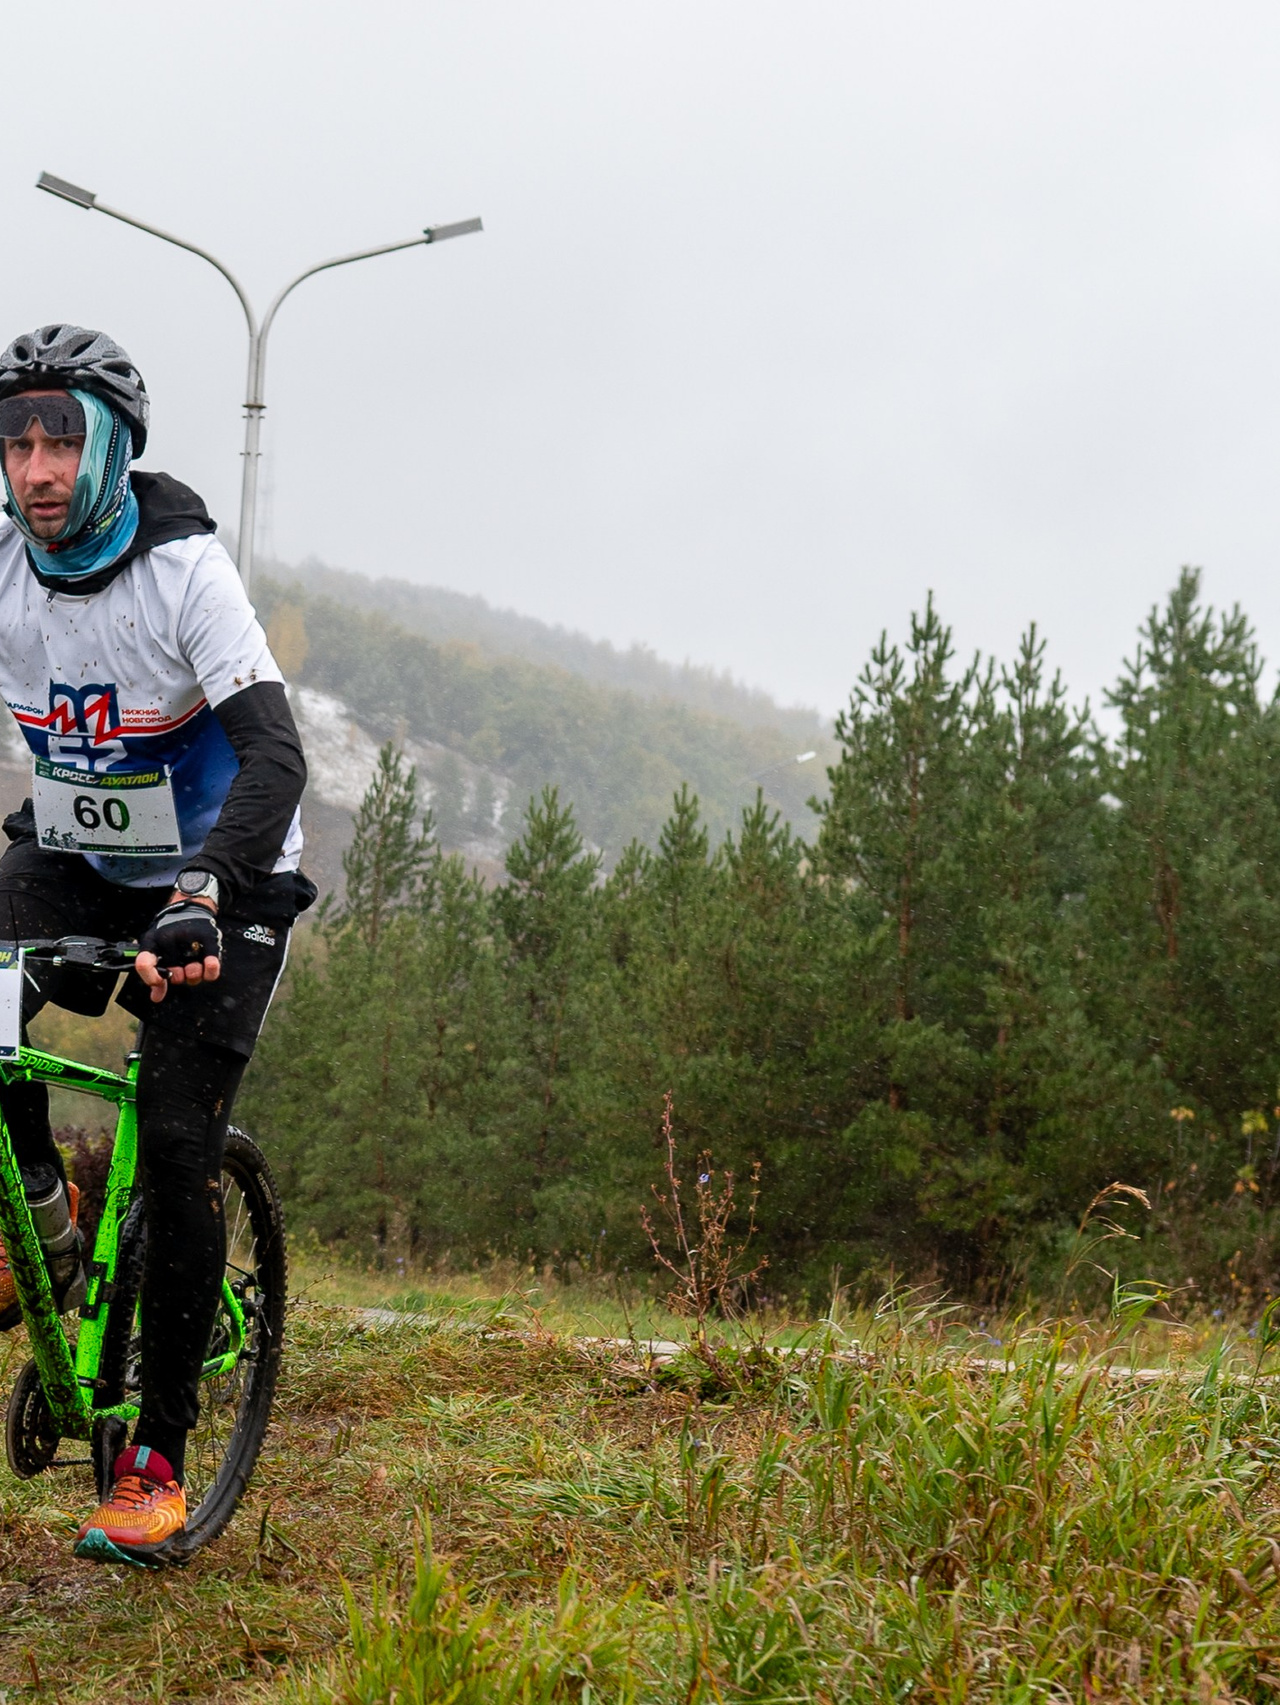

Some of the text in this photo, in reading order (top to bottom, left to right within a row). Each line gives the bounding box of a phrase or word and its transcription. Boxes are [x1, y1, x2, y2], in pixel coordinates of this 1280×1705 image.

[5, 701, 44, 715] АРАФОН
[122, 715, 172, 723] НОВГОРОД
[52, 766, 98, 784] КРОСС
[100, 772, 159, 787] ДУАТЛОН
[73, 795, 130, 831] 60
[243, 930, 275, 946] adidas
[14, 1052, 64, 1074] SPIDER
